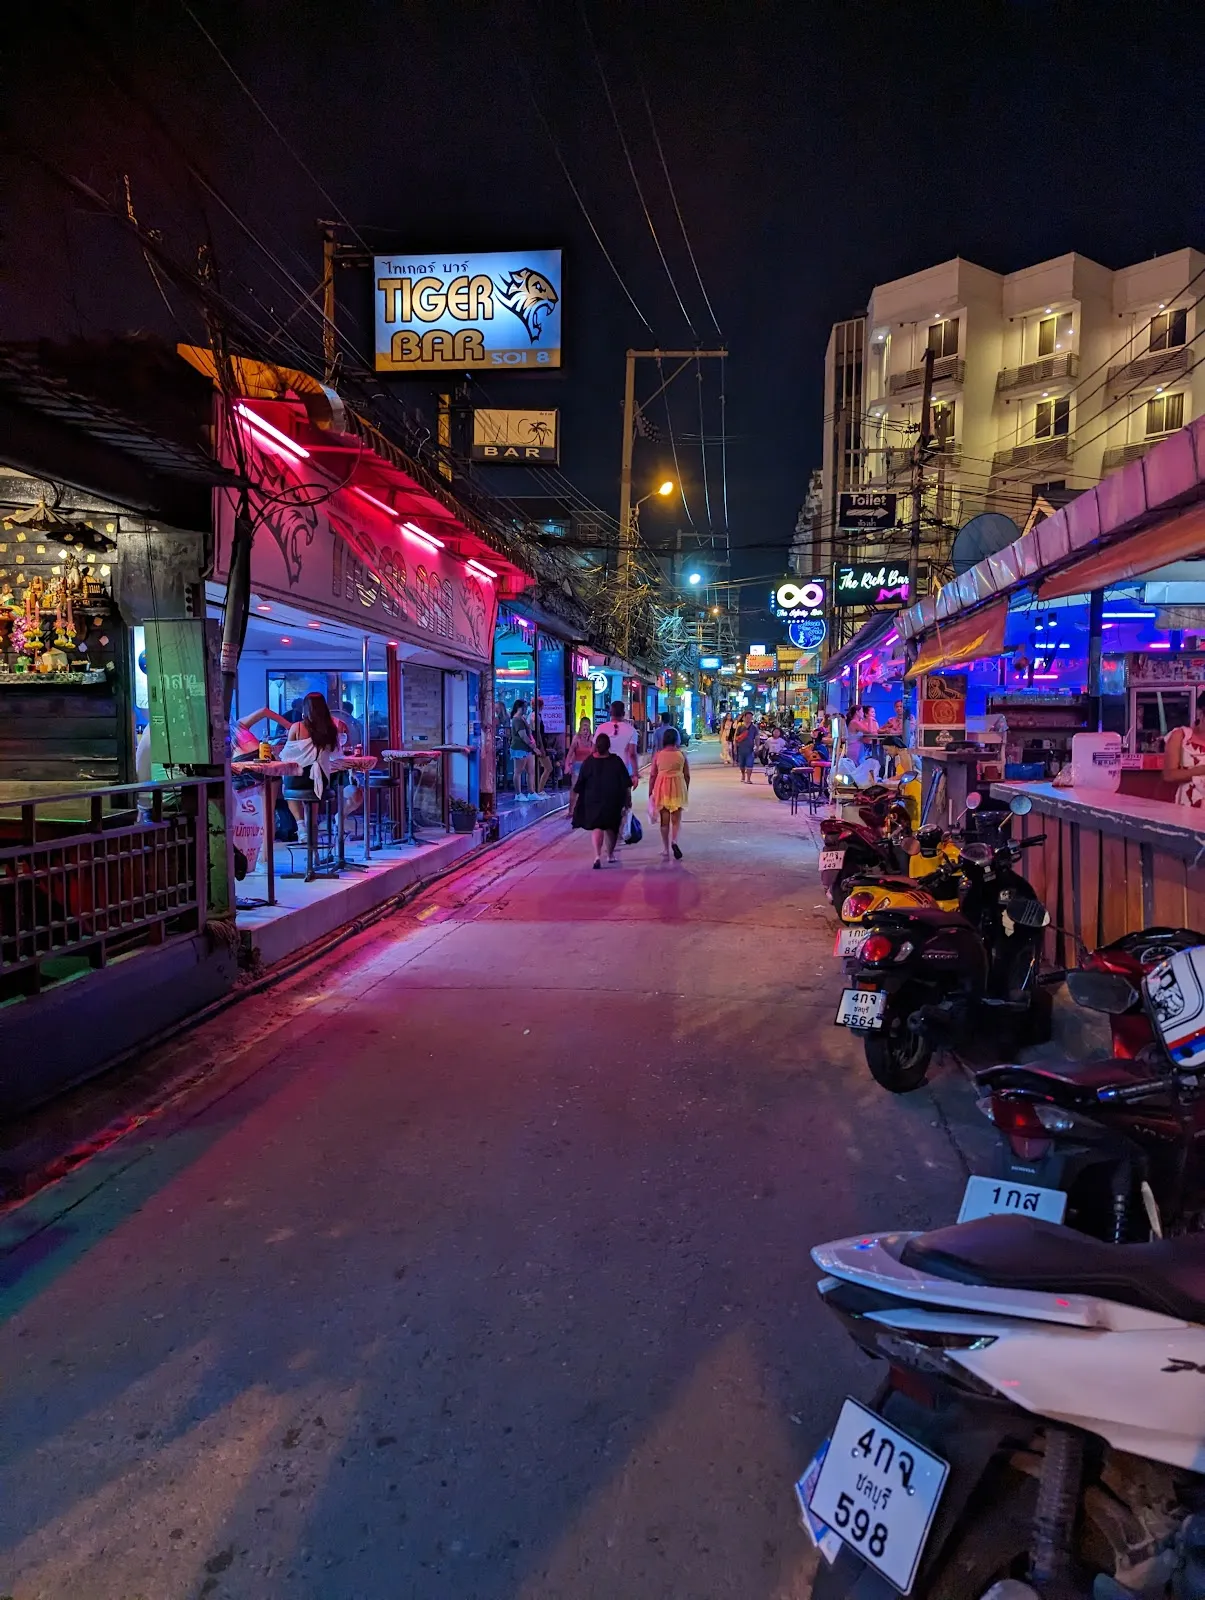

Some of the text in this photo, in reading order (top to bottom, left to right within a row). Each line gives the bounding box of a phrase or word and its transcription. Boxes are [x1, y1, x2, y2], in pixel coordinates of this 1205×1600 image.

[382, 260, 469, 274] ไทเกอร์ บาร์
[377, 274, 494, 323] TIGER
[391, 328, 485, 362] BAR
[492, 351, 550, 365] SOI 8
[484, 446, 541, 458] BAR
[850, 494, 887, 506] Toilet
[839, 567, 909, 590] The Rich Bar
[415, 564, 454, 641] BAR
[842, 1013, 874, 1026] 5564
[992, 1186, 1042, 1212] 1กส
[856, 1473, 892, 1510] ชลบุรี
[834, 1491, 888, 1558] 598
